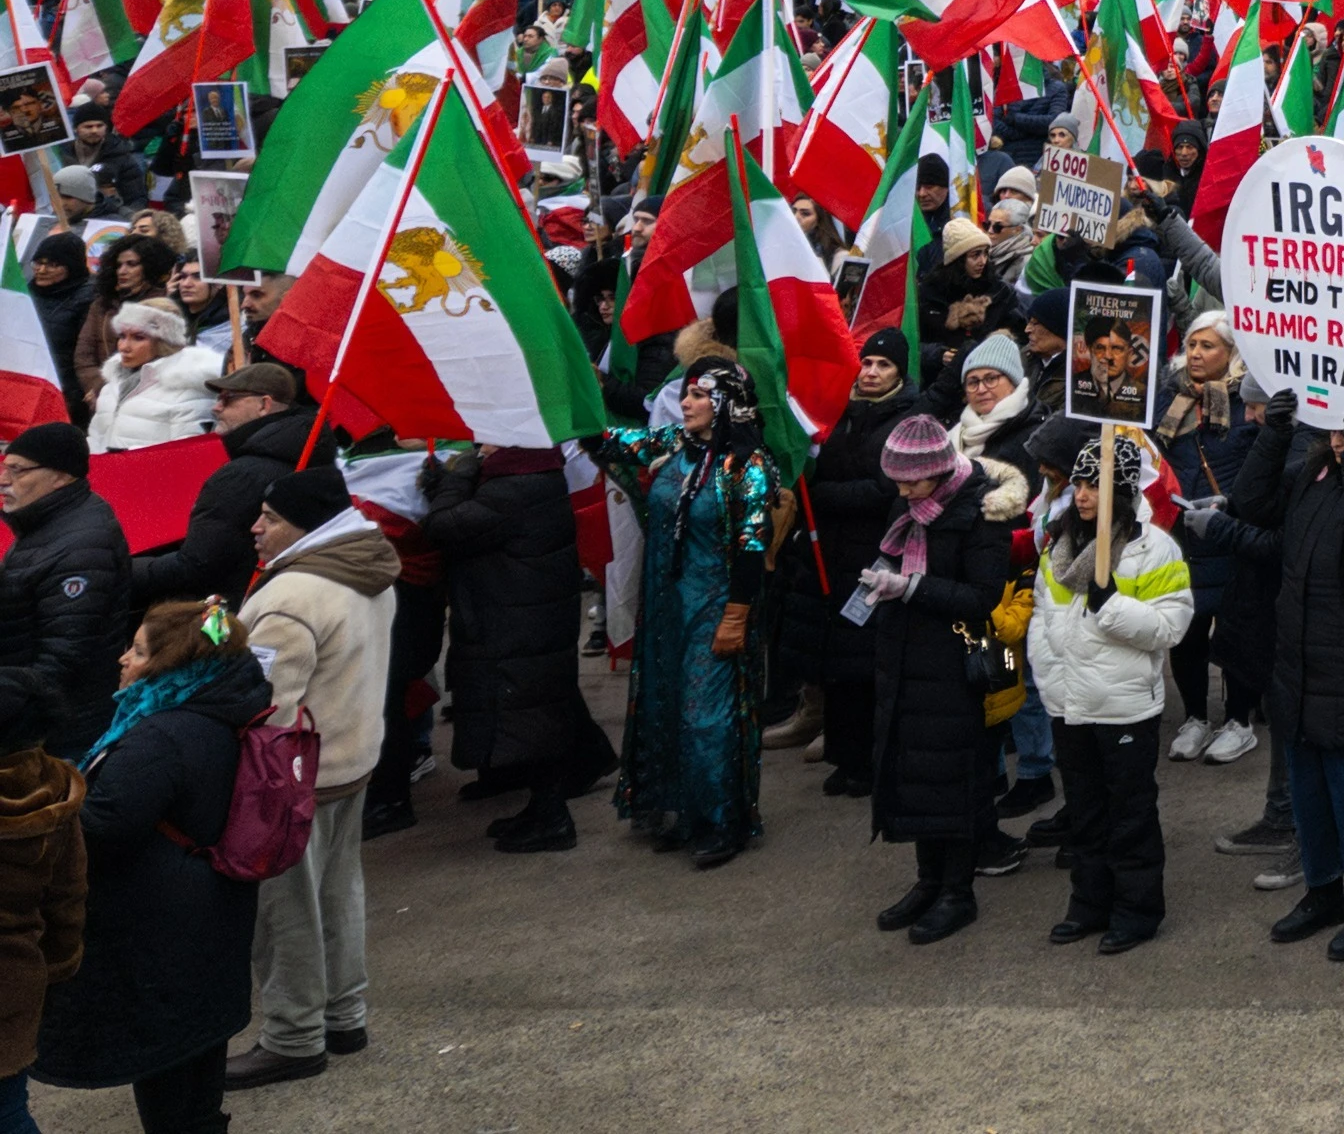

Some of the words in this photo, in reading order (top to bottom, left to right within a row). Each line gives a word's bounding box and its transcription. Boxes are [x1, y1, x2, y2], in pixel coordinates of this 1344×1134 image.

[1044, 147, 1060, 172] 16
[1063, 153, 1087, 178] 000
[1056, 181, 1112, 217] MURDERED
[1060, 213, 1069, 234] 2
[1076, 216, 1106, 243] DAYS
[1086, 295, 1119, 309] HITLER
[1267, 277, 1318, 306] END
[1102, 308, 1134, 319] CENTURY
[1233, 305, 1318, 344] ISLAMIC
[1274, 348, 1301, 378] IN
[1078, 380, 1092, 390] 500
[1122, 386, 1137, 395] 200
